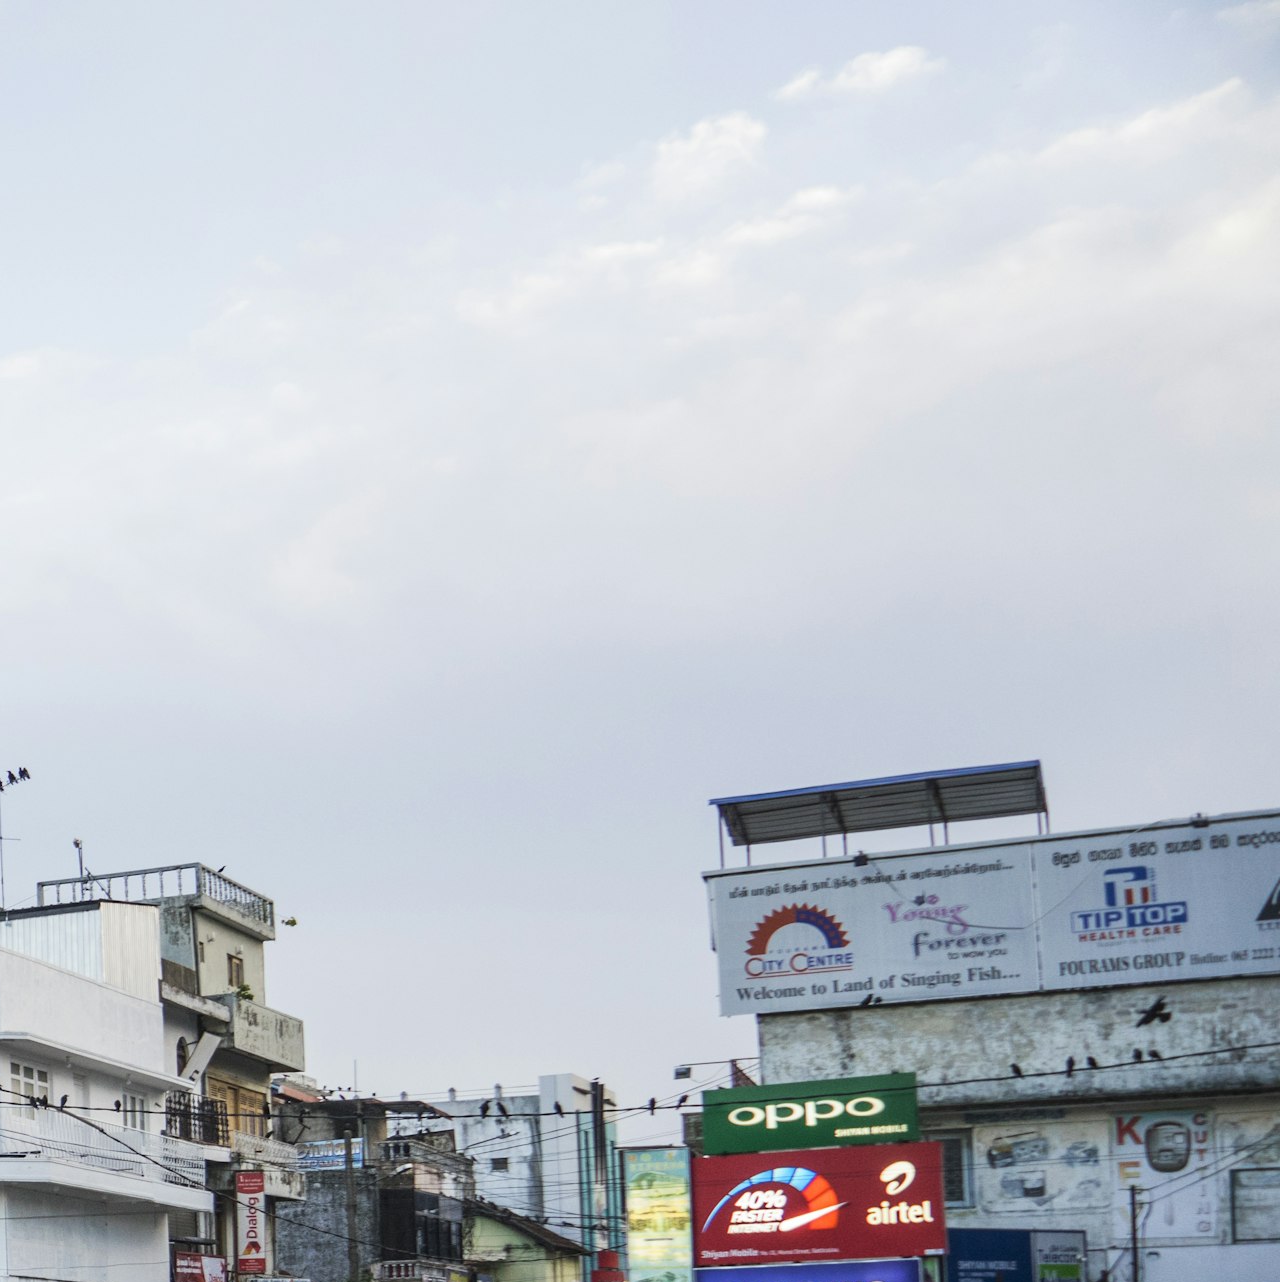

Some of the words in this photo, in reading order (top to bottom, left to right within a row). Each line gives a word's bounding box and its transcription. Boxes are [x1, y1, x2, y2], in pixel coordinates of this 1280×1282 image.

[882, 902, 972, 935] Young
[1076, 911, 1124, 930] TIP
[1128, 903, 1186, 926] TOP
[912, 931, 1009, 958] forever
[1078, 929, 1137, 943] HEALTH
[1142, 924, 1183, 937] CARE
[987, 949, 1009, 960] you
[1058, 956, 1131, 977] FOURAMS
[1132, 951, 1186, 971] GROUP
[736, 985, 806, 1001] Welcome
[811, 983, 827, 996] to
[833, 977, 874, 994] Land
[879, 974, 897, 989] of
[900, 968, 961, 989] Singing
[834, 1126, 870, 1138] SHIYAN
[871, 1123, 909, 1135] MOBILE
[734, 1188, 788, 1210] 40%
[246, 1196, 260, 1239] Dialog
[730, 1208, 784, 1224] FASTER
[866, 1200, 935, 1226] airtel
[726, 1222, 780, 1235] INTERNET
[730, 1247, 759, 1257] Mobile
